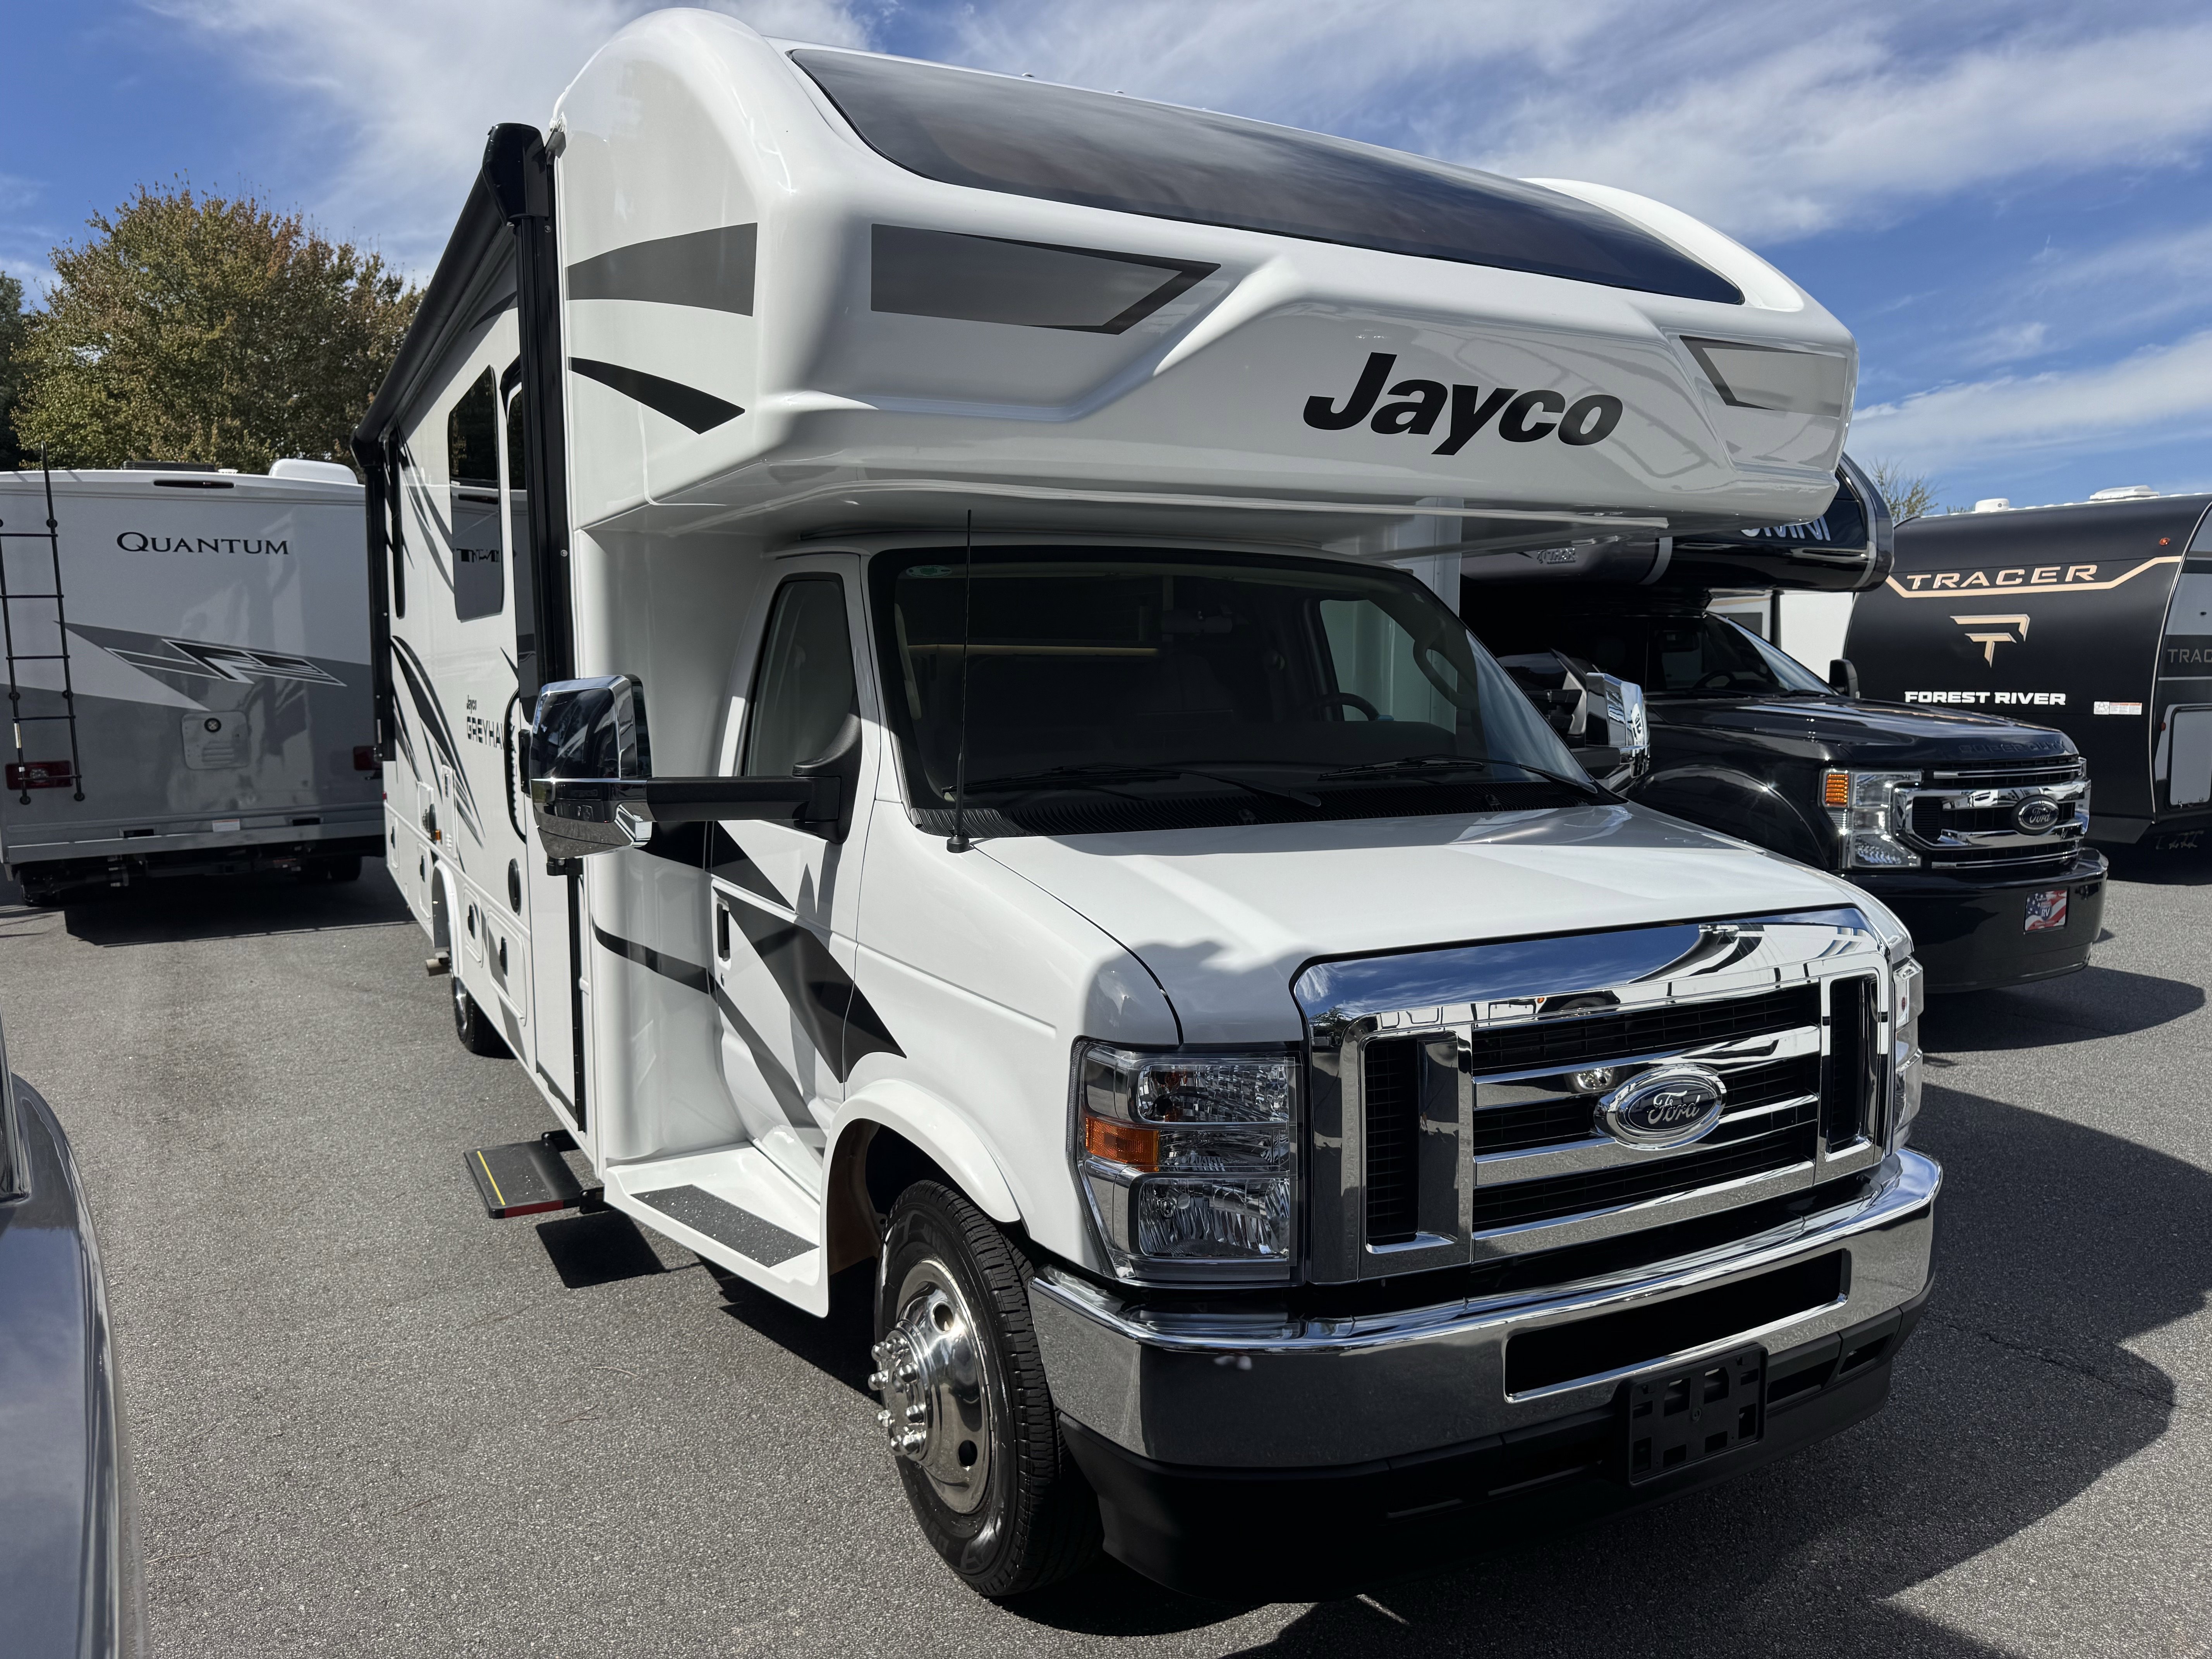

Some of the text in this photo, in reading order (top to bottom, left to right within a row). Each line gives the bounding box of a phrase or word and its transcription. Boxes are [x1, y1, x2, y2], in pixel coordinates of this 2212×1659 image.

[1303, 352, 1623, 455] Jayco
[117, 532, 289, 555] QUANTUM
[1907, 565, 2098, 589] TRACER
[467, 695, 477, 714] Jayco
[1905, 691, 2066, 705] FOREST RIVER
[467, 716, 517, 753] GREYHA
[2030, 807, 2051, 824] Ford
[2041, 908, 2050, 918] RV
[1648, 1090, 1700, 1125] Ford
